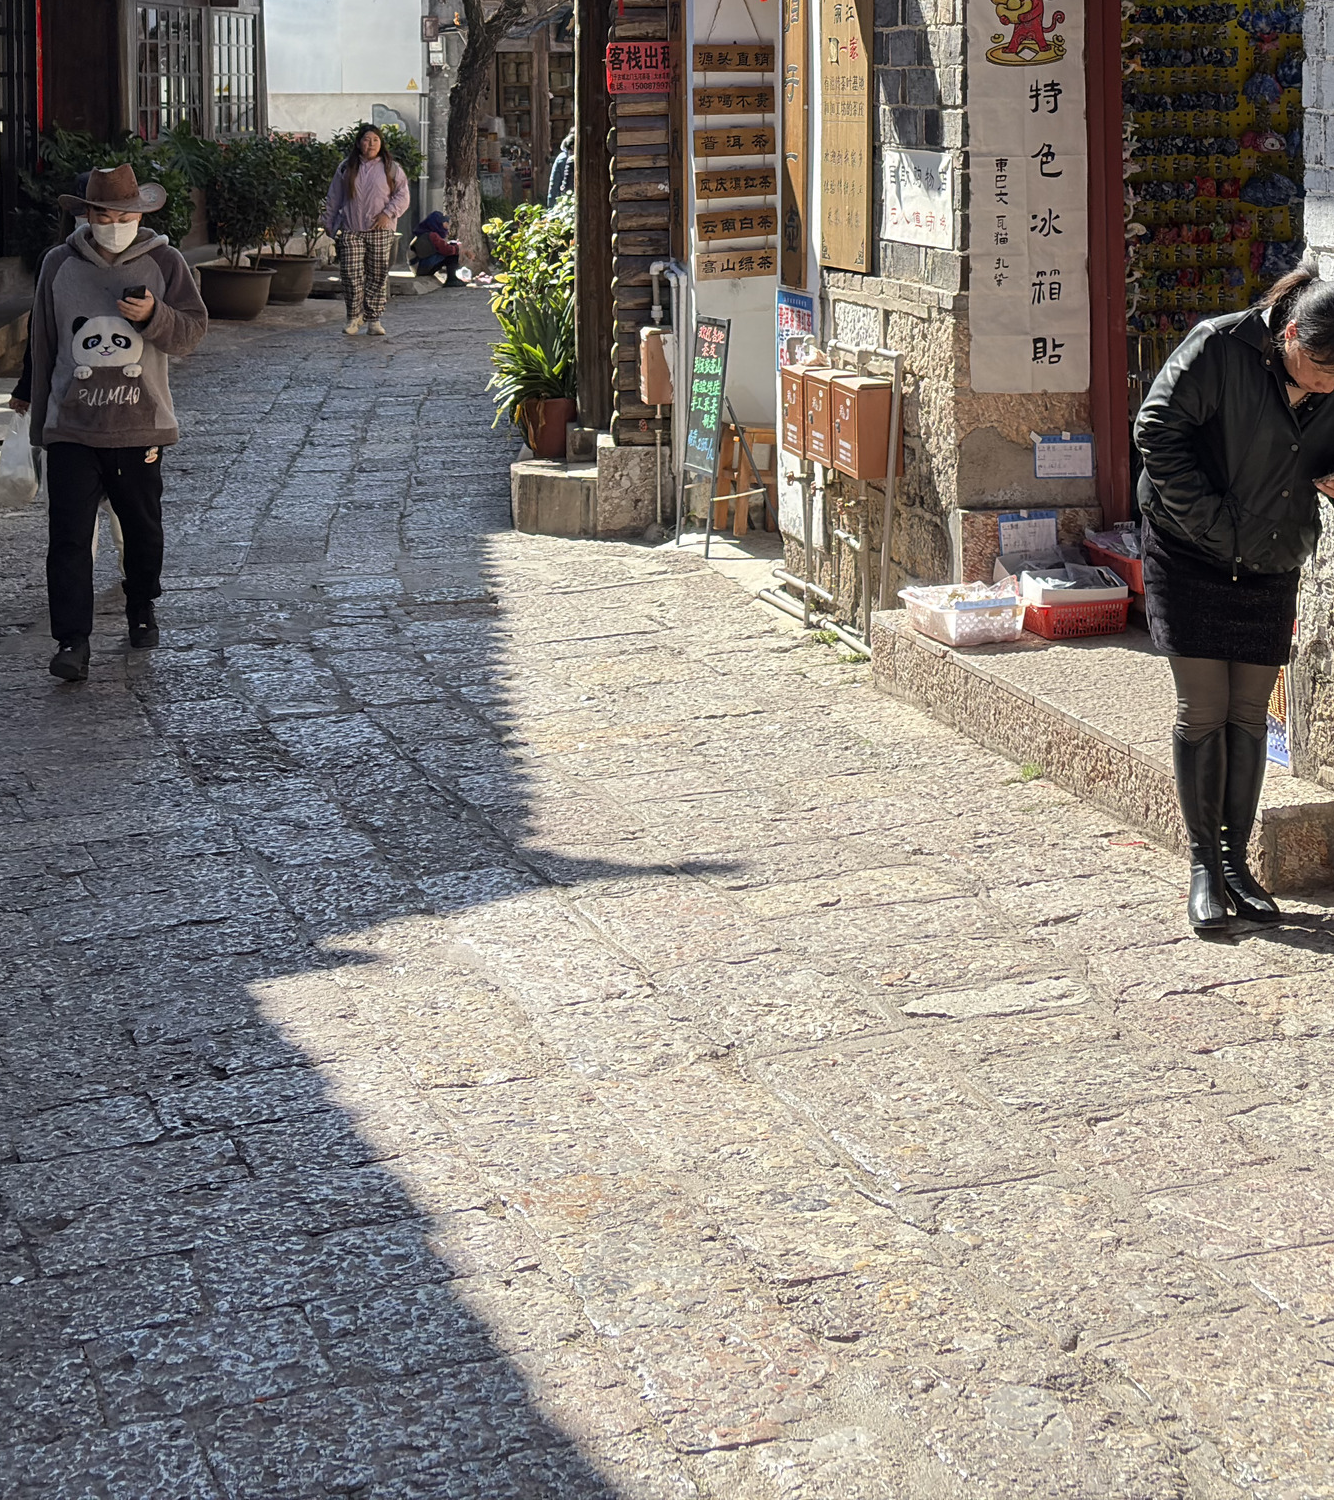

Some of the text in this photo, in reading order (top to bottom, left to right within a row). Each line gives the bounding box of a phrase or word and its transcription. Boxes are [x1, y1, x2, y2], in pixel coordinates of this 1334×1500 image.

[698, 51, 771, 67] 源头直销
[698, 92, 770, 109] 好喝不贵
[702, 133, 770, 151] 普洱茶
[702, 214, 774, 235] 云南白茶
[701, 254, 773, 275] 高山绿茶
